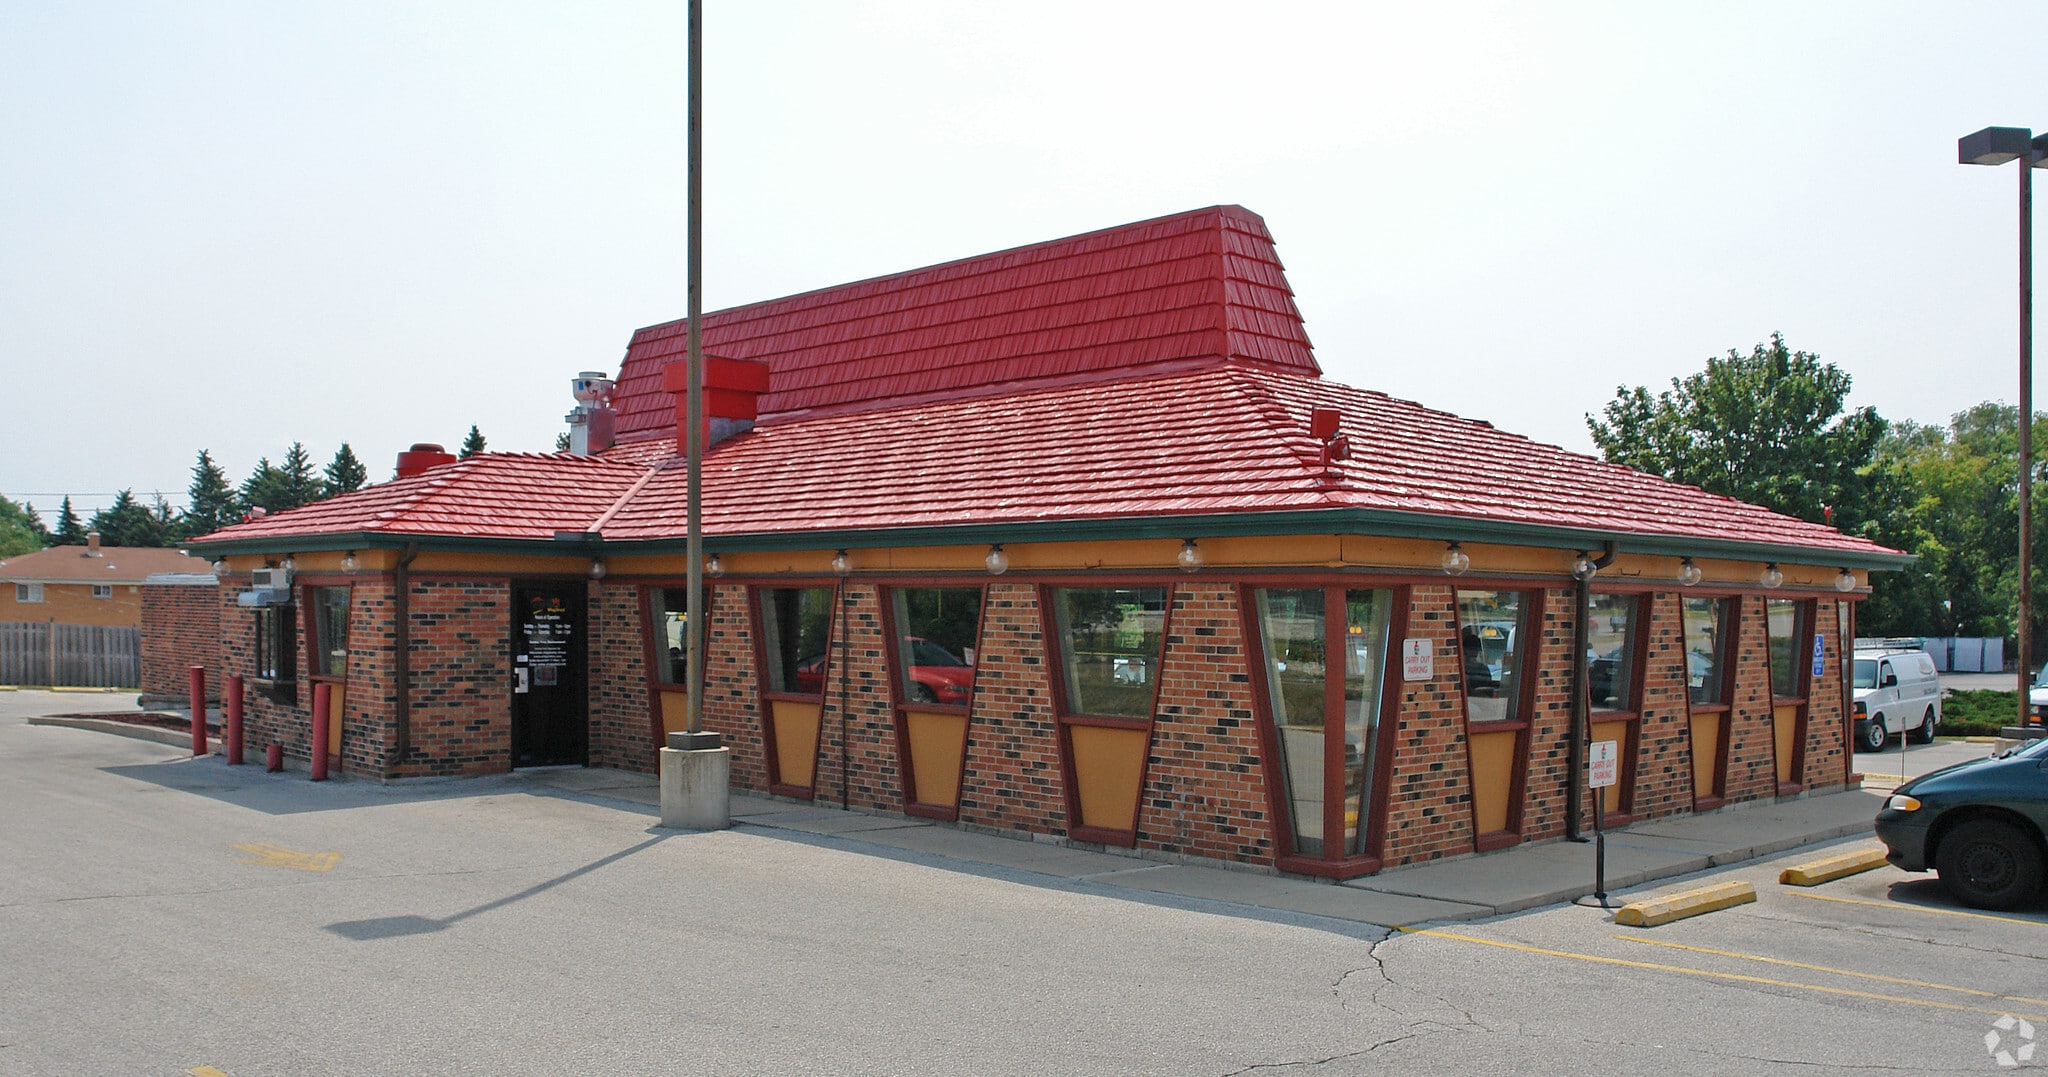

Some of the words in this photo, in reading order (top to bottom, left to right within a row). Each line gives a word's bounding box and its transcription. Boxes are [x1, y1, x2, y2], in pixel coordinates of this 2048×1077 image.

[1405, 656, 1419, 664] CARRY
[1420, 655, 1430, 663] OUT
[1594, 771, 1612, 780] PARKING
